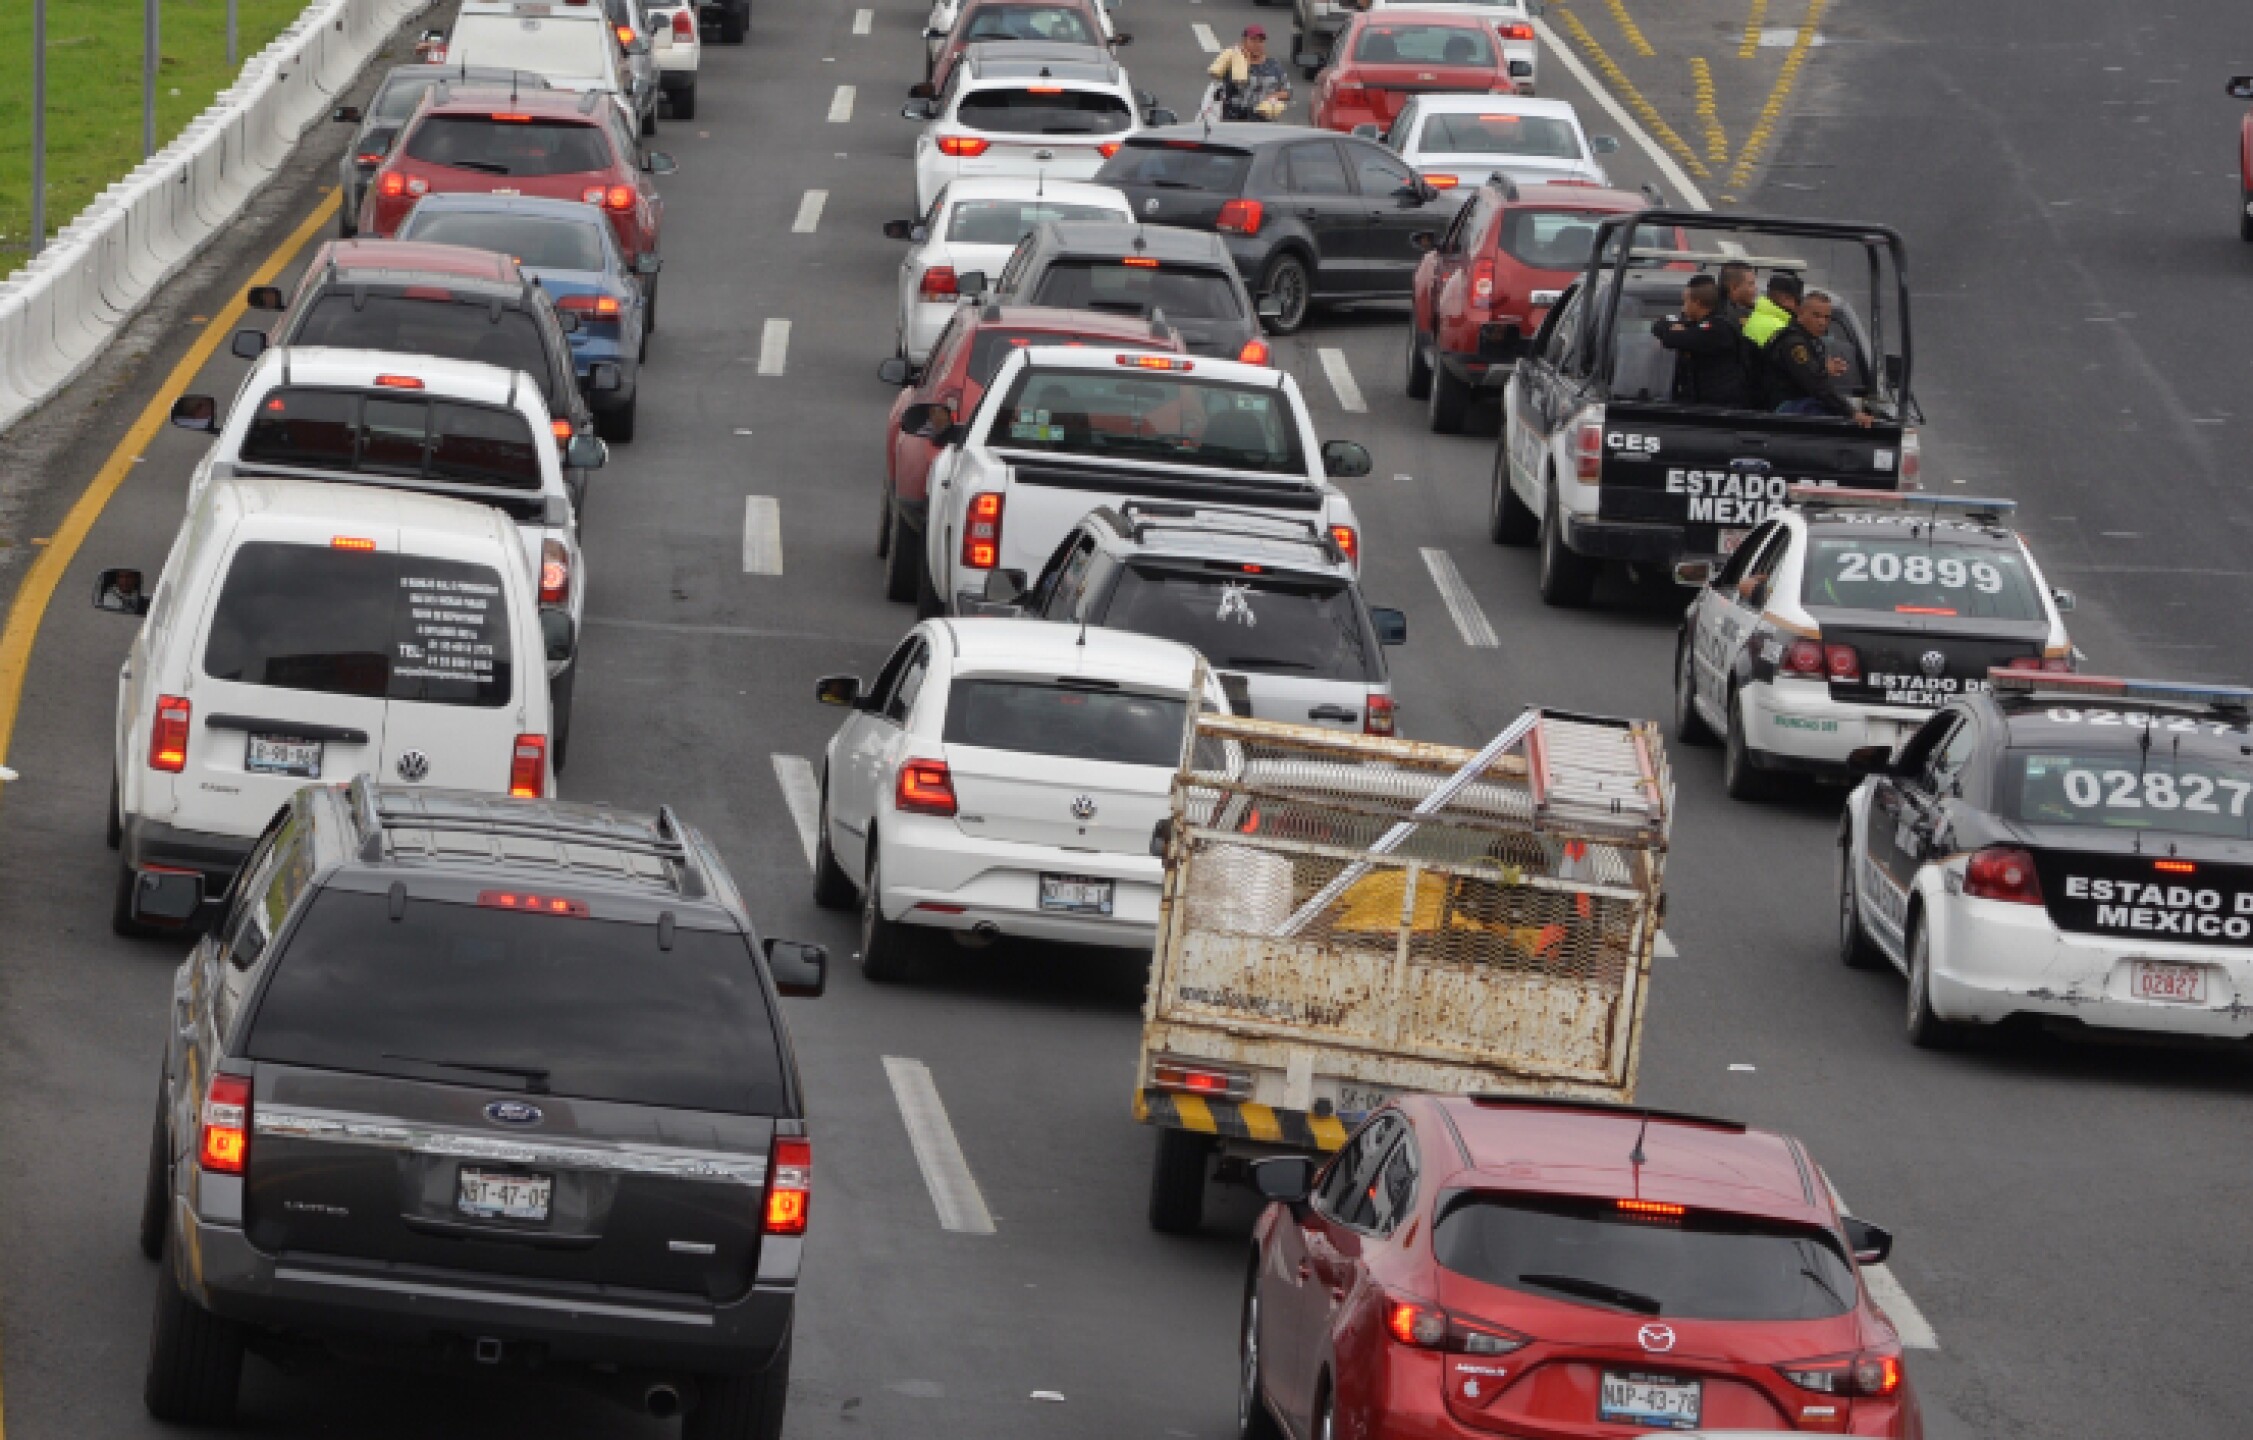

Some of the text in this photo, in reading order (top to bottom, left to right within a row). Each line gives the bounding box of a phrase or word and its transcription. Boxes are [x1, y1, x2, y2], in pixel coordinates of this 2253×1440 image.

[1666, 468, 1787, 499] ESTADO
[1837, 553, 2003, 594] 20899
[1868, 672, 1957, 692] ESTADO
[2063, 769, 2253, 817] 02827
[2066, 875, 2222, 911] ESTADO
[2096, 904, 2251, 939] MEXICO
